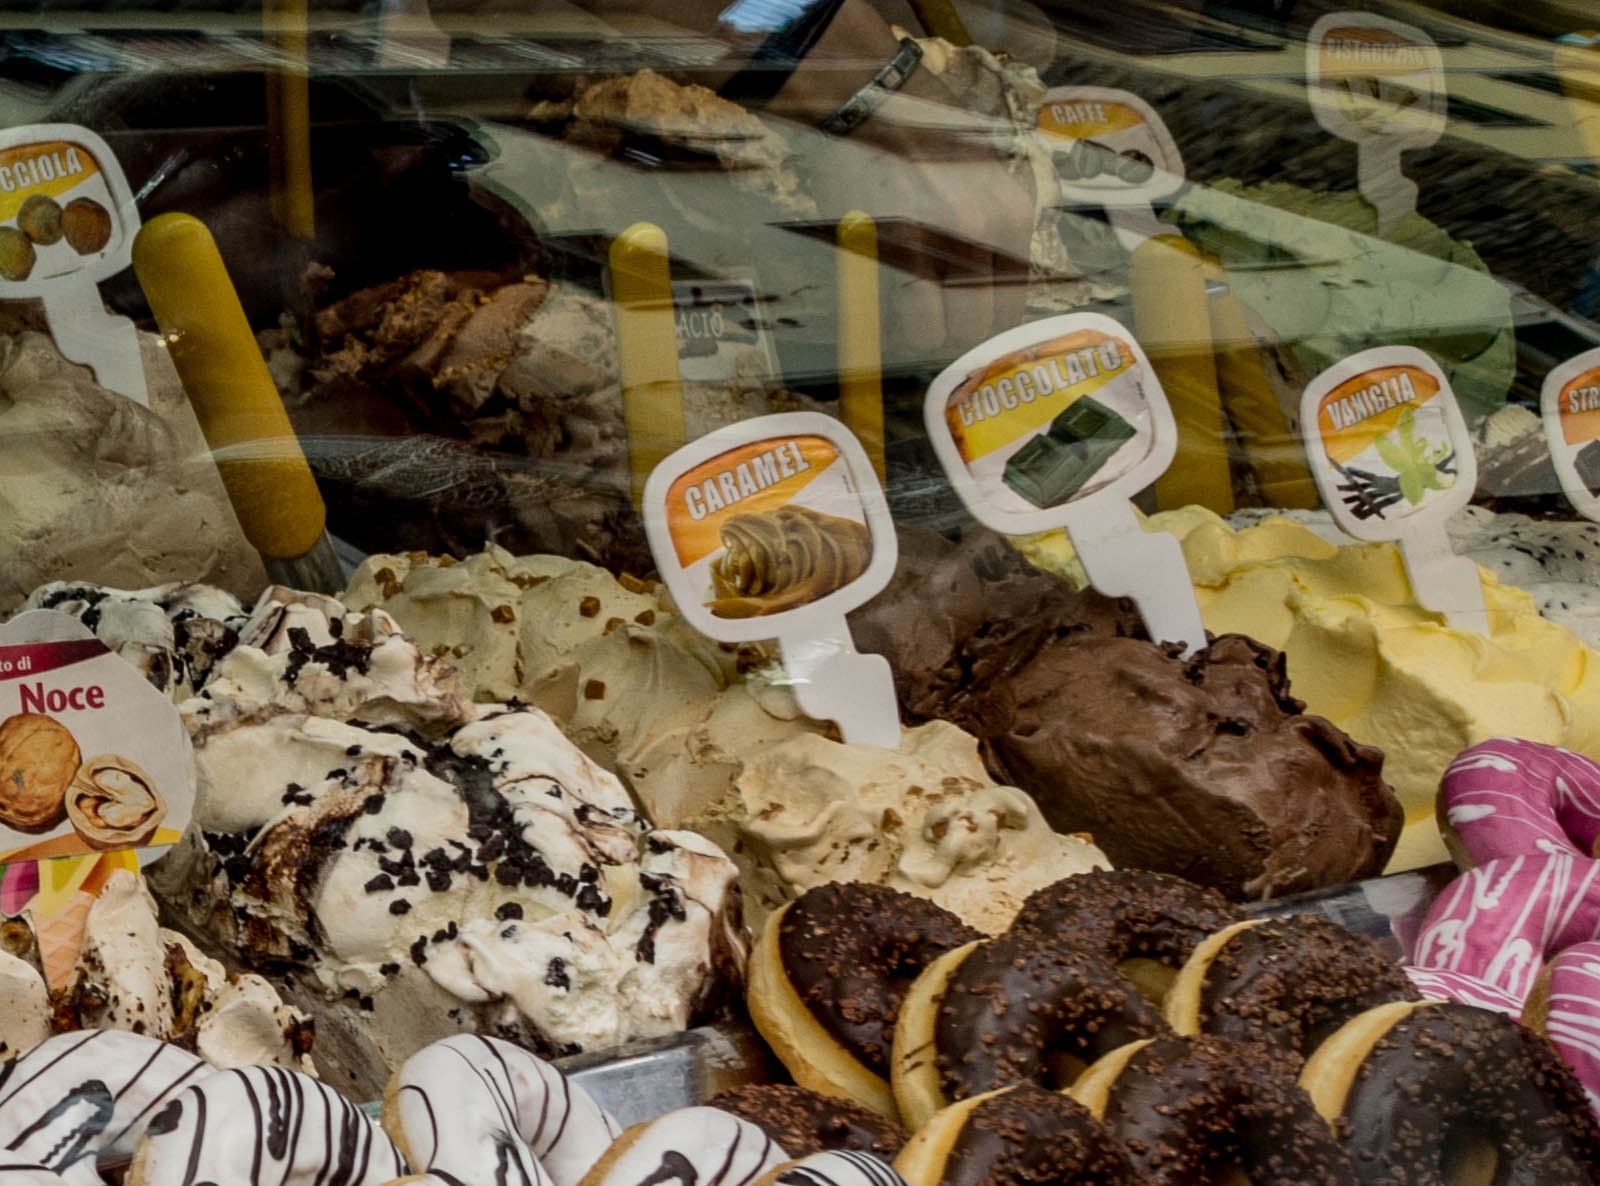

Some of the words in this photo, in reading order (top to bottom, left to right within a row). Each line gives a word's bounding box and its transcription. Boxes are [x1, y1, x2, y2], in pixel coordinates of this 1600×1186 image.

[677, 311, 723, 338] ACIO
[958, 340, 1122, 427] CIOCCOLATO
[1568, 386, 1600, 413] STR
[1326, 372, 1416, 432] VANIGLIA
[684, 441, 810, 520] CARAMEL
[17, 656, 31, 671] di
[19, 682, 104, 714] Noce
